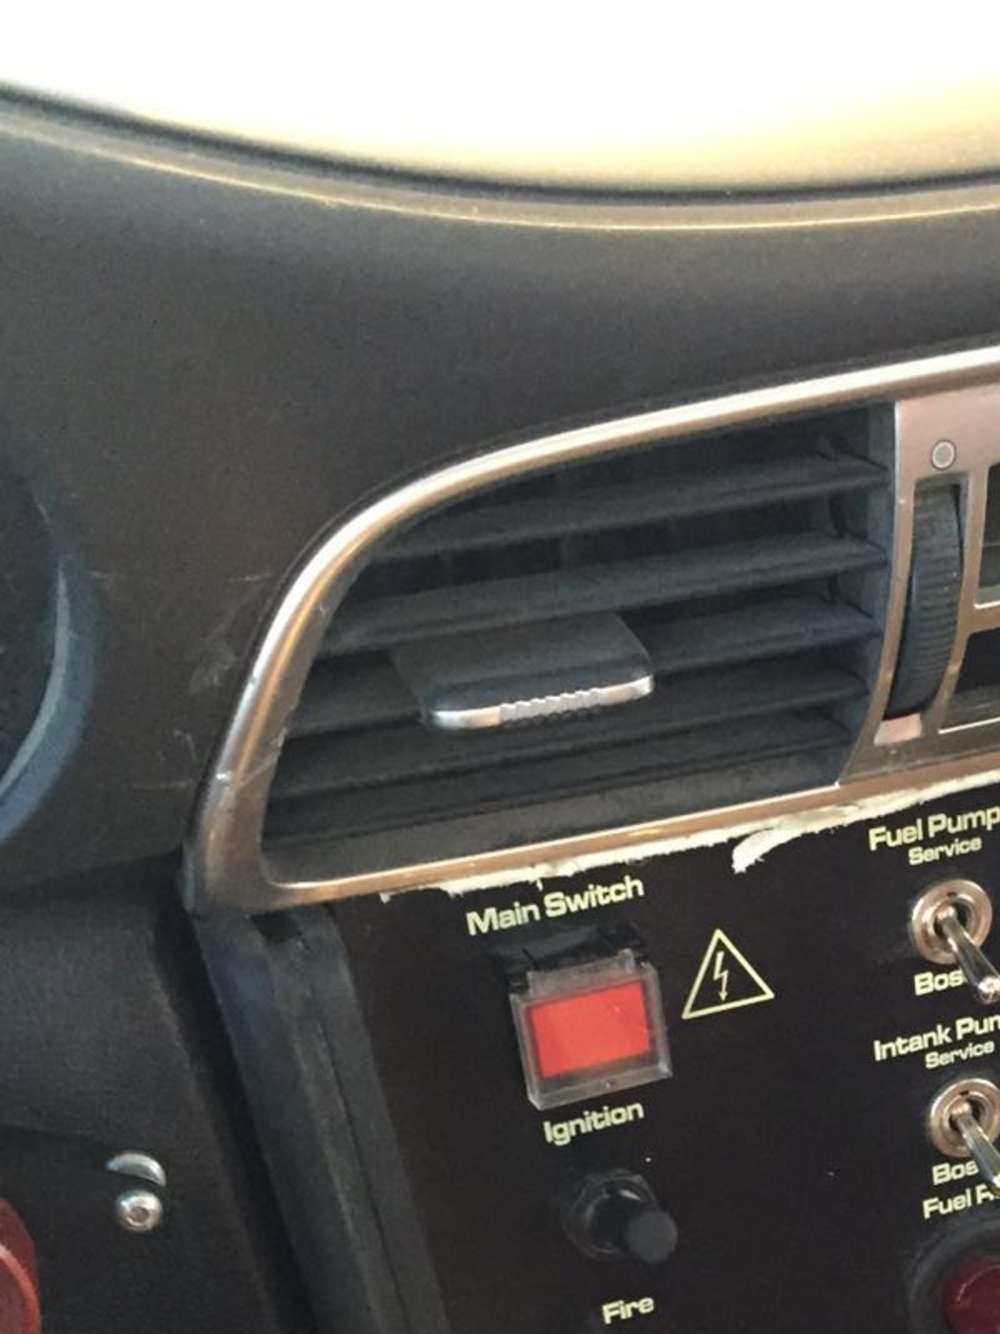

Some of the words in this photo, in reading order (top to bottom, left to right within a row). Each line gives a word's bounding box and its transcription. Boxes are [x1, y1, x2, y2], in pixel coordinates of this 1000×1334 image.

[868, 818, 924, 852] Fuel
[908, 837, 982, 866] Service
[465, 901, 541, 936] Main
[543, 874, 645, 918] Switch
[913, 967, 966, 996] Bos
[873, 1023, 953, 1062] Intank
[924, 1040, 995, 1070] Service
[543, 1102, 645, 1146] Ignition
[922, 1187, 973, 1220] Fuel
[601, 1297, 655, 1325] Fire
